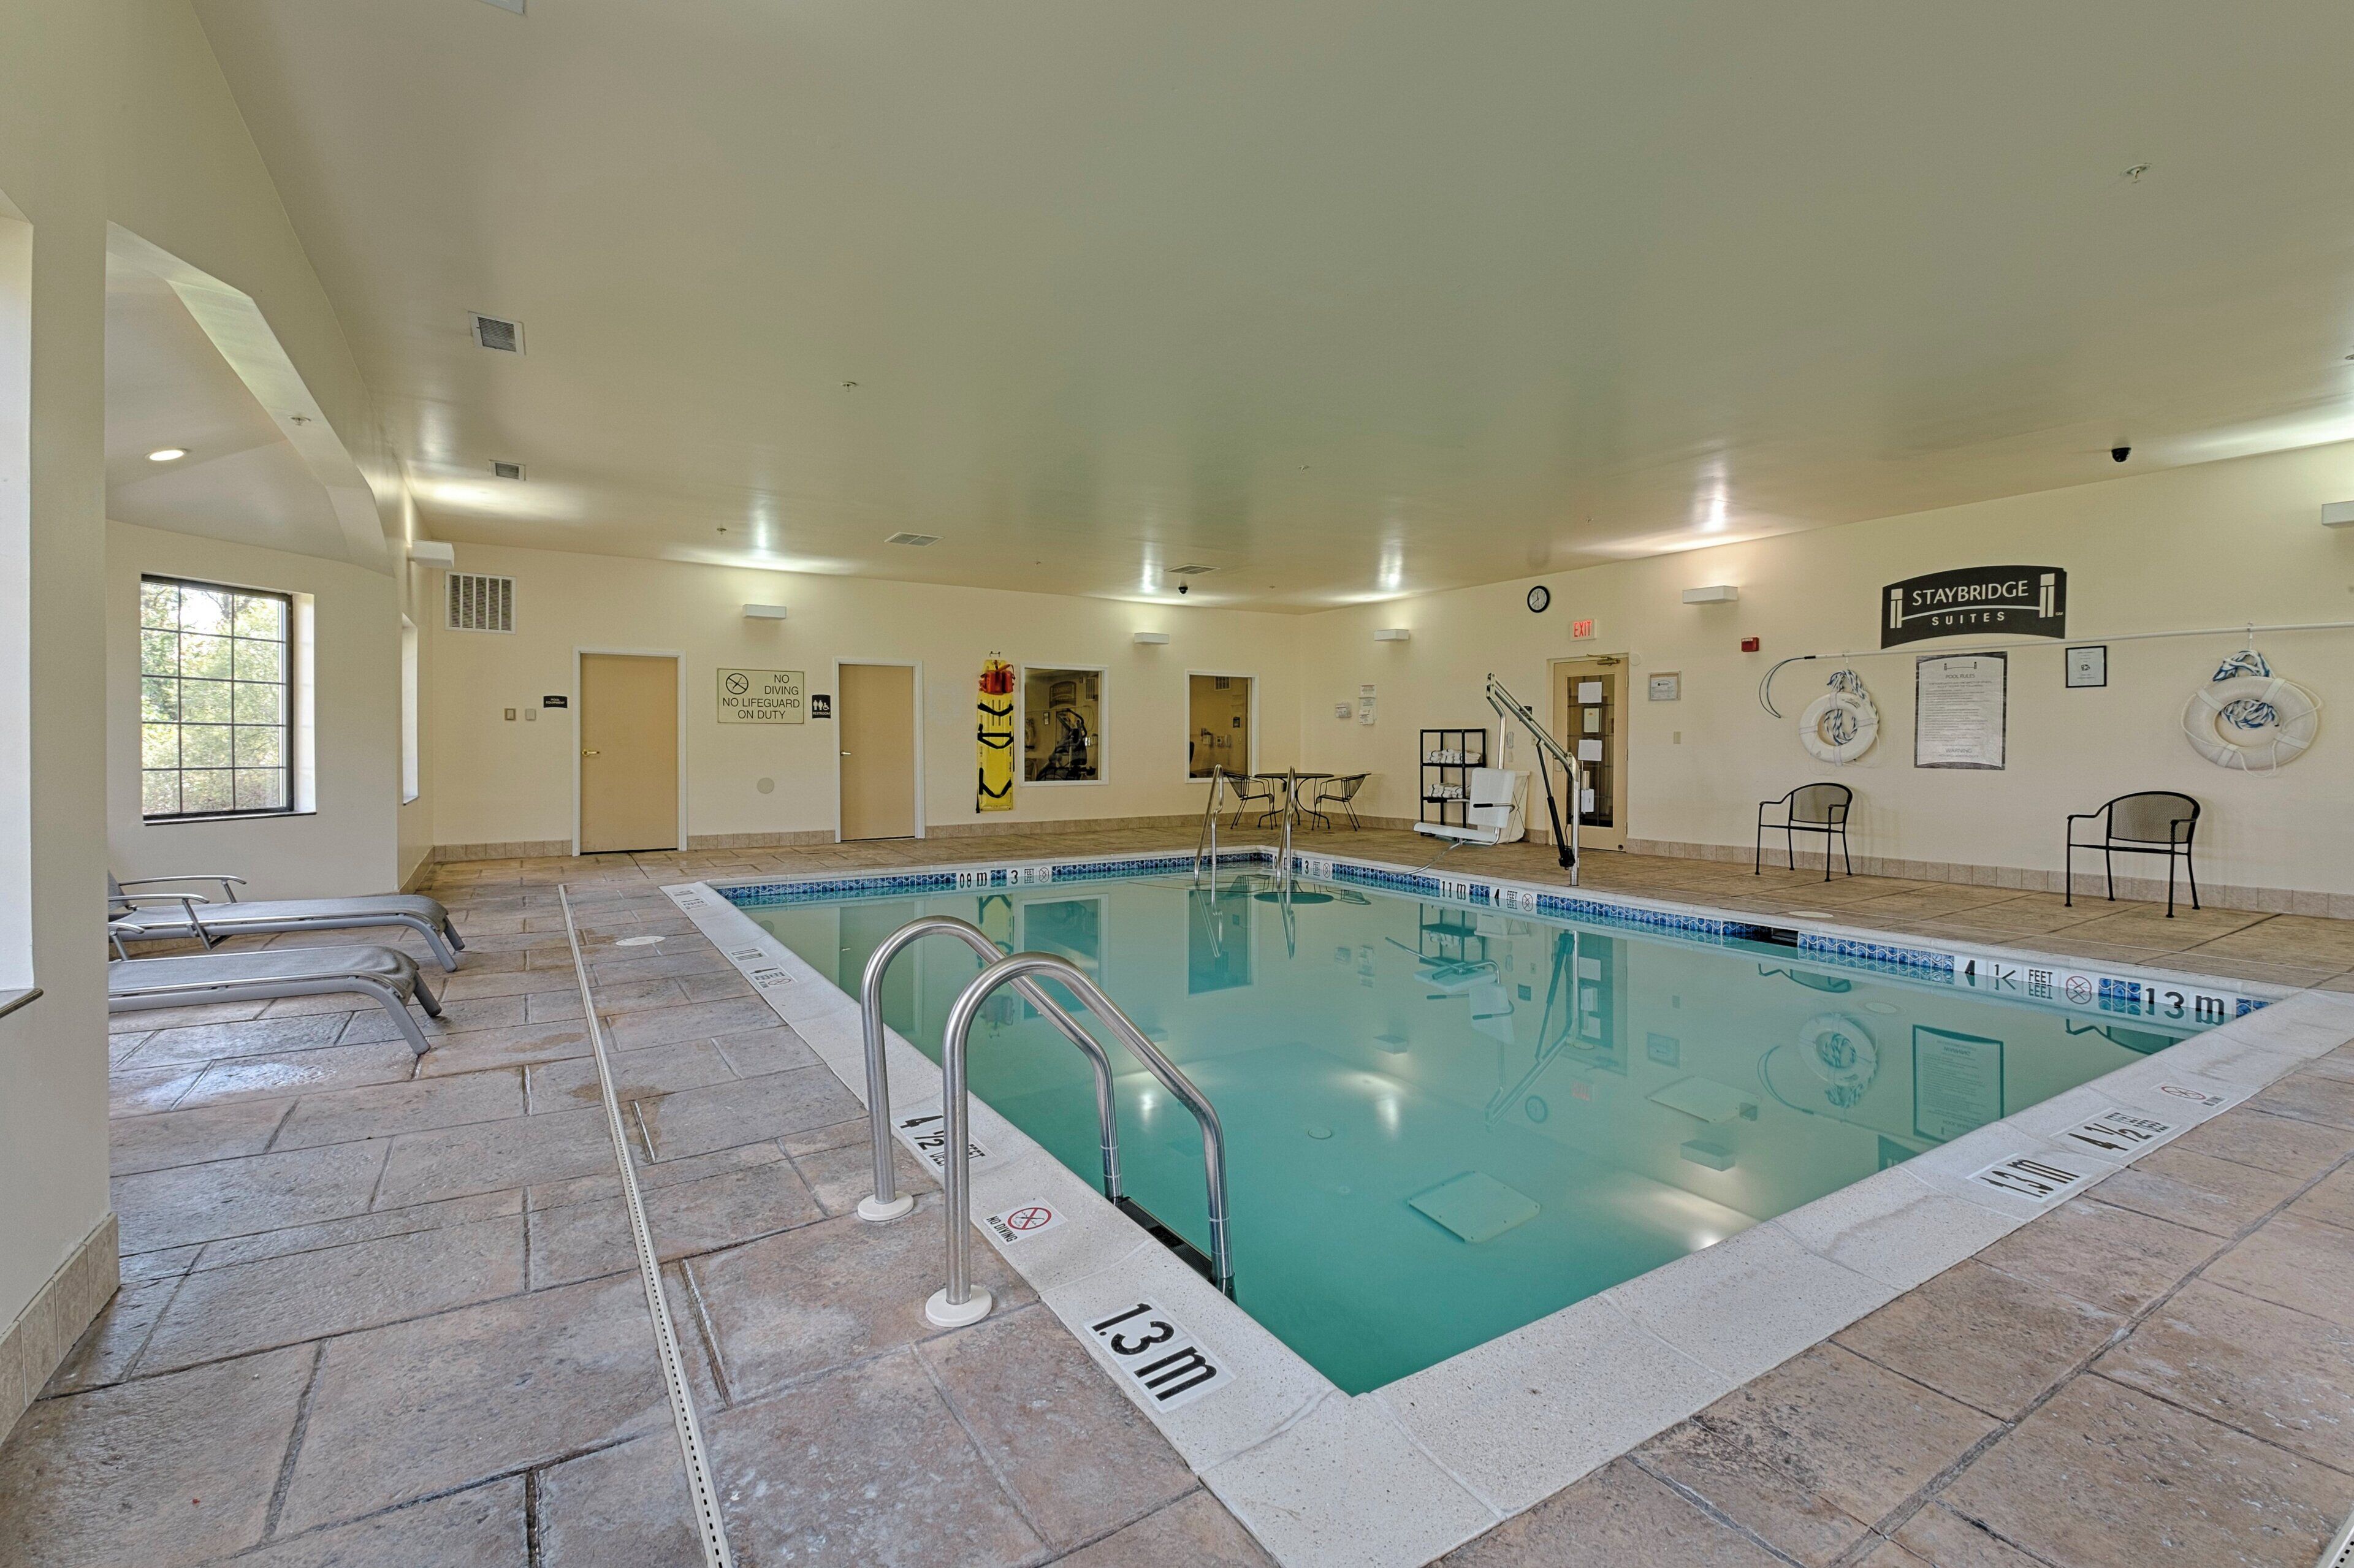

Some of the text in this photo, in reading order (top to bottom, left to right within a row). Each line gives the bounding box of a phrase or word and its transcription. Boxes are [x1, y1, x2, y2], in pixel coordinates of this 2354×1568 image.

[1912, 580, 2029, 606] STAYBRIDGE
[1932, 611, 2005, 626] SUITES
[1574, 621, 1591, 637] EXIT
[774, 674, 790, 683] NO
[764, 685, 799, 695] DIVING
[723, 698, 800, 707] NO LIFEGUARD
[737, 710, 785, 719] ON DUTY
[1507, 890, 1518, 901] FEET
[2028, 969, 2053, 986] FEET
[986, 1216, 1018, 1243] NO DIVING
[1092, 1303, 1217, 1402] 1.3 m
